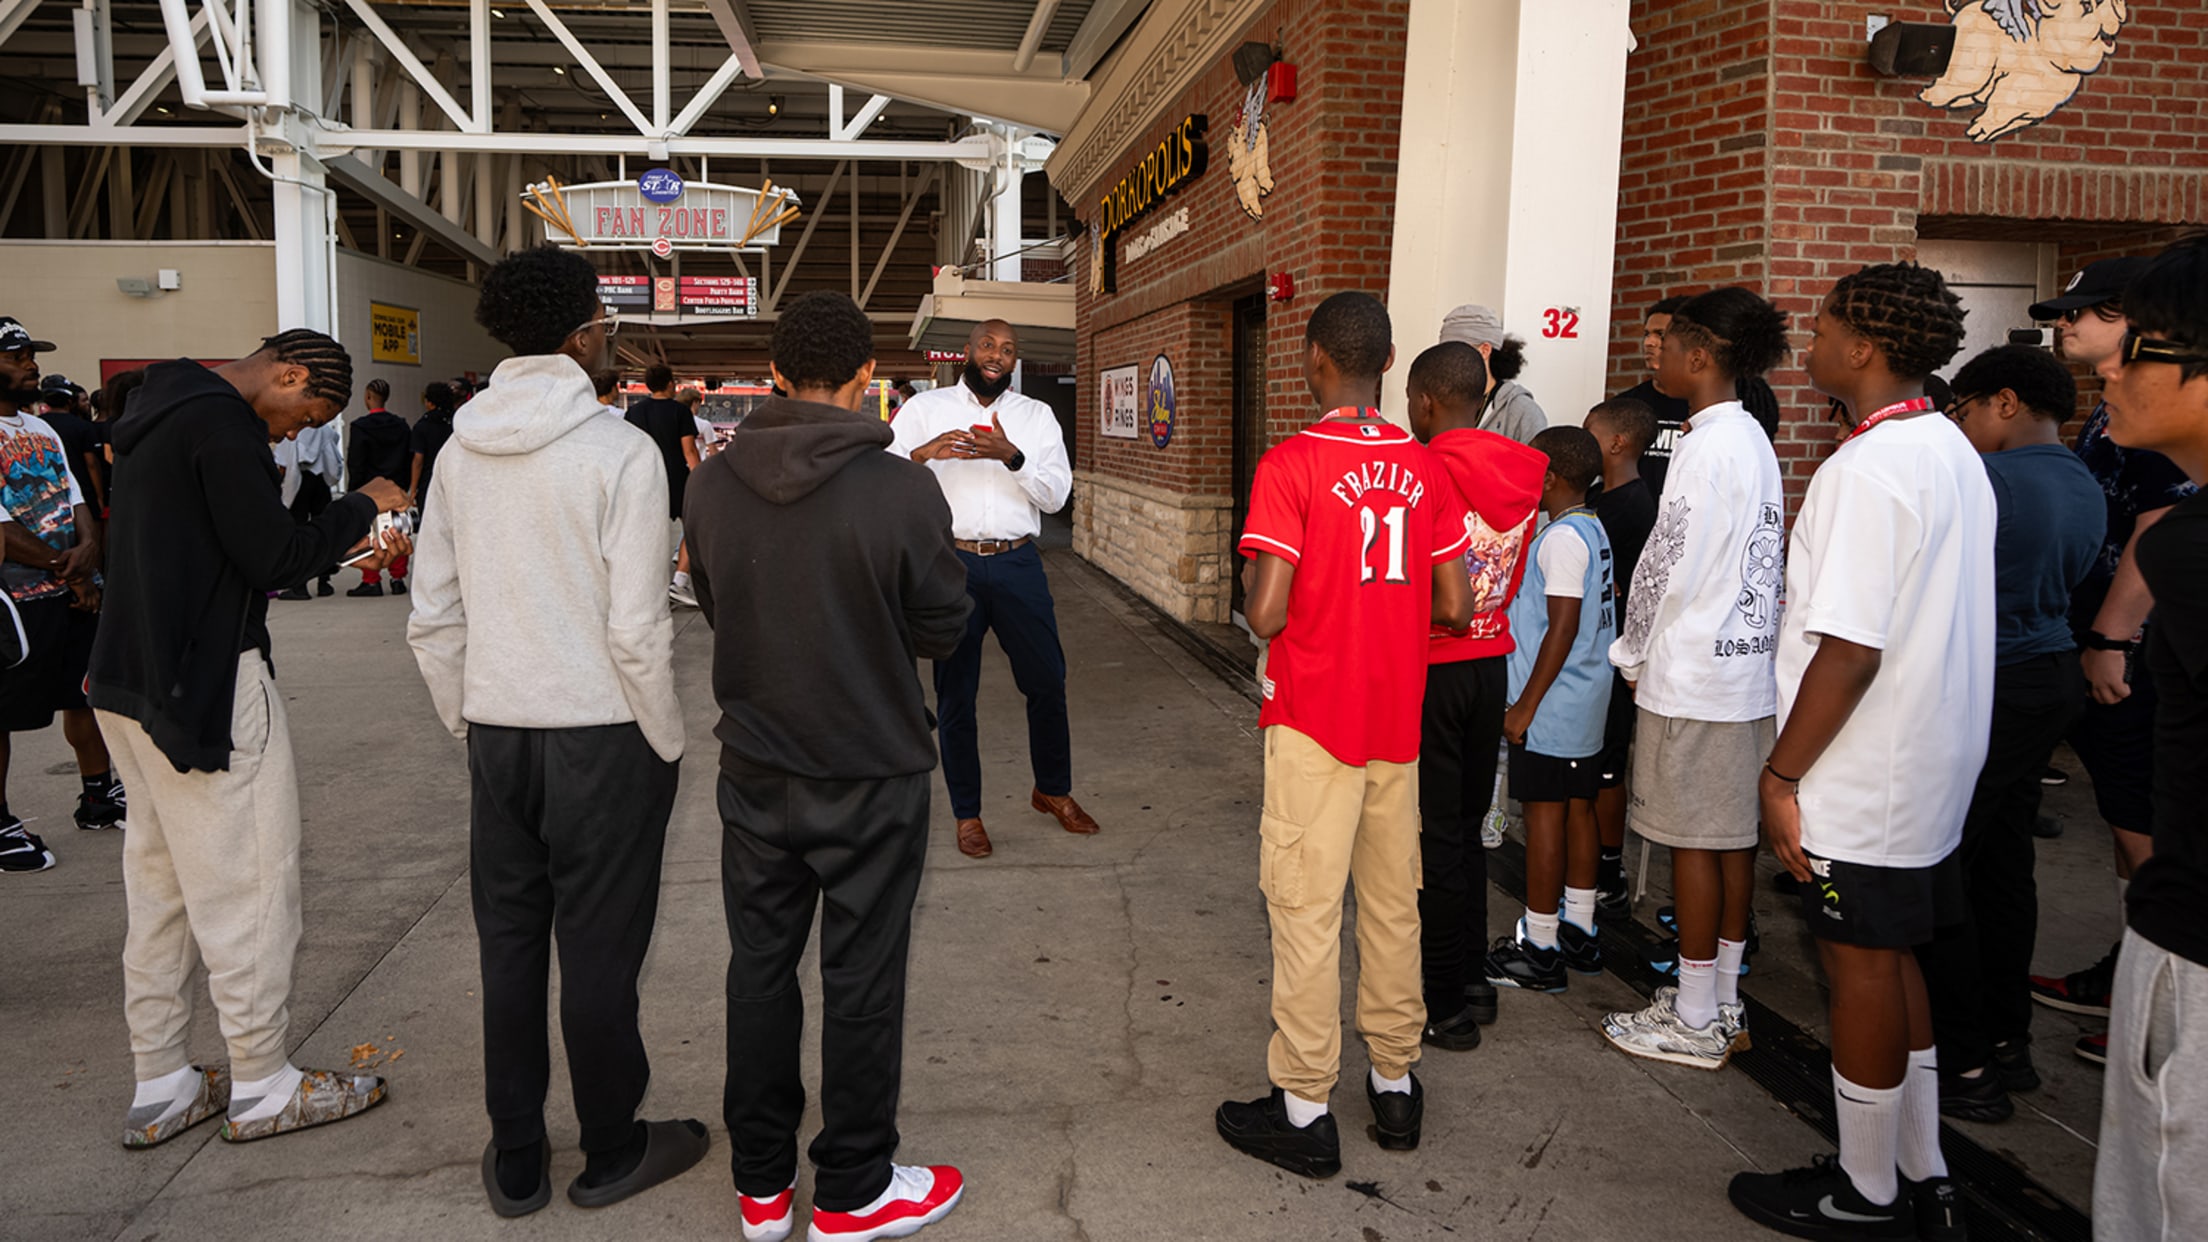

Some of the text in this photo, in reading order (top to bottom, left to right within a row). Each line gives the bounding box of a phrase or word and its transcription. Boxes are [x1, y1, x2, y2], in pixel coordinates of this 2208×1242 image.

[1101, 115, 1200, 292] PORKOPOLIS
[596, 207, 726, 237] FAN ZONE
[374, 322, 406, 339] MOBILE
[1542, 308, 1579, 339] 32
[382, 339, 400, 353] APP
[1331, 461, 1425, 509] FRAZIER
[1360, 505, 1410, 586] 21
